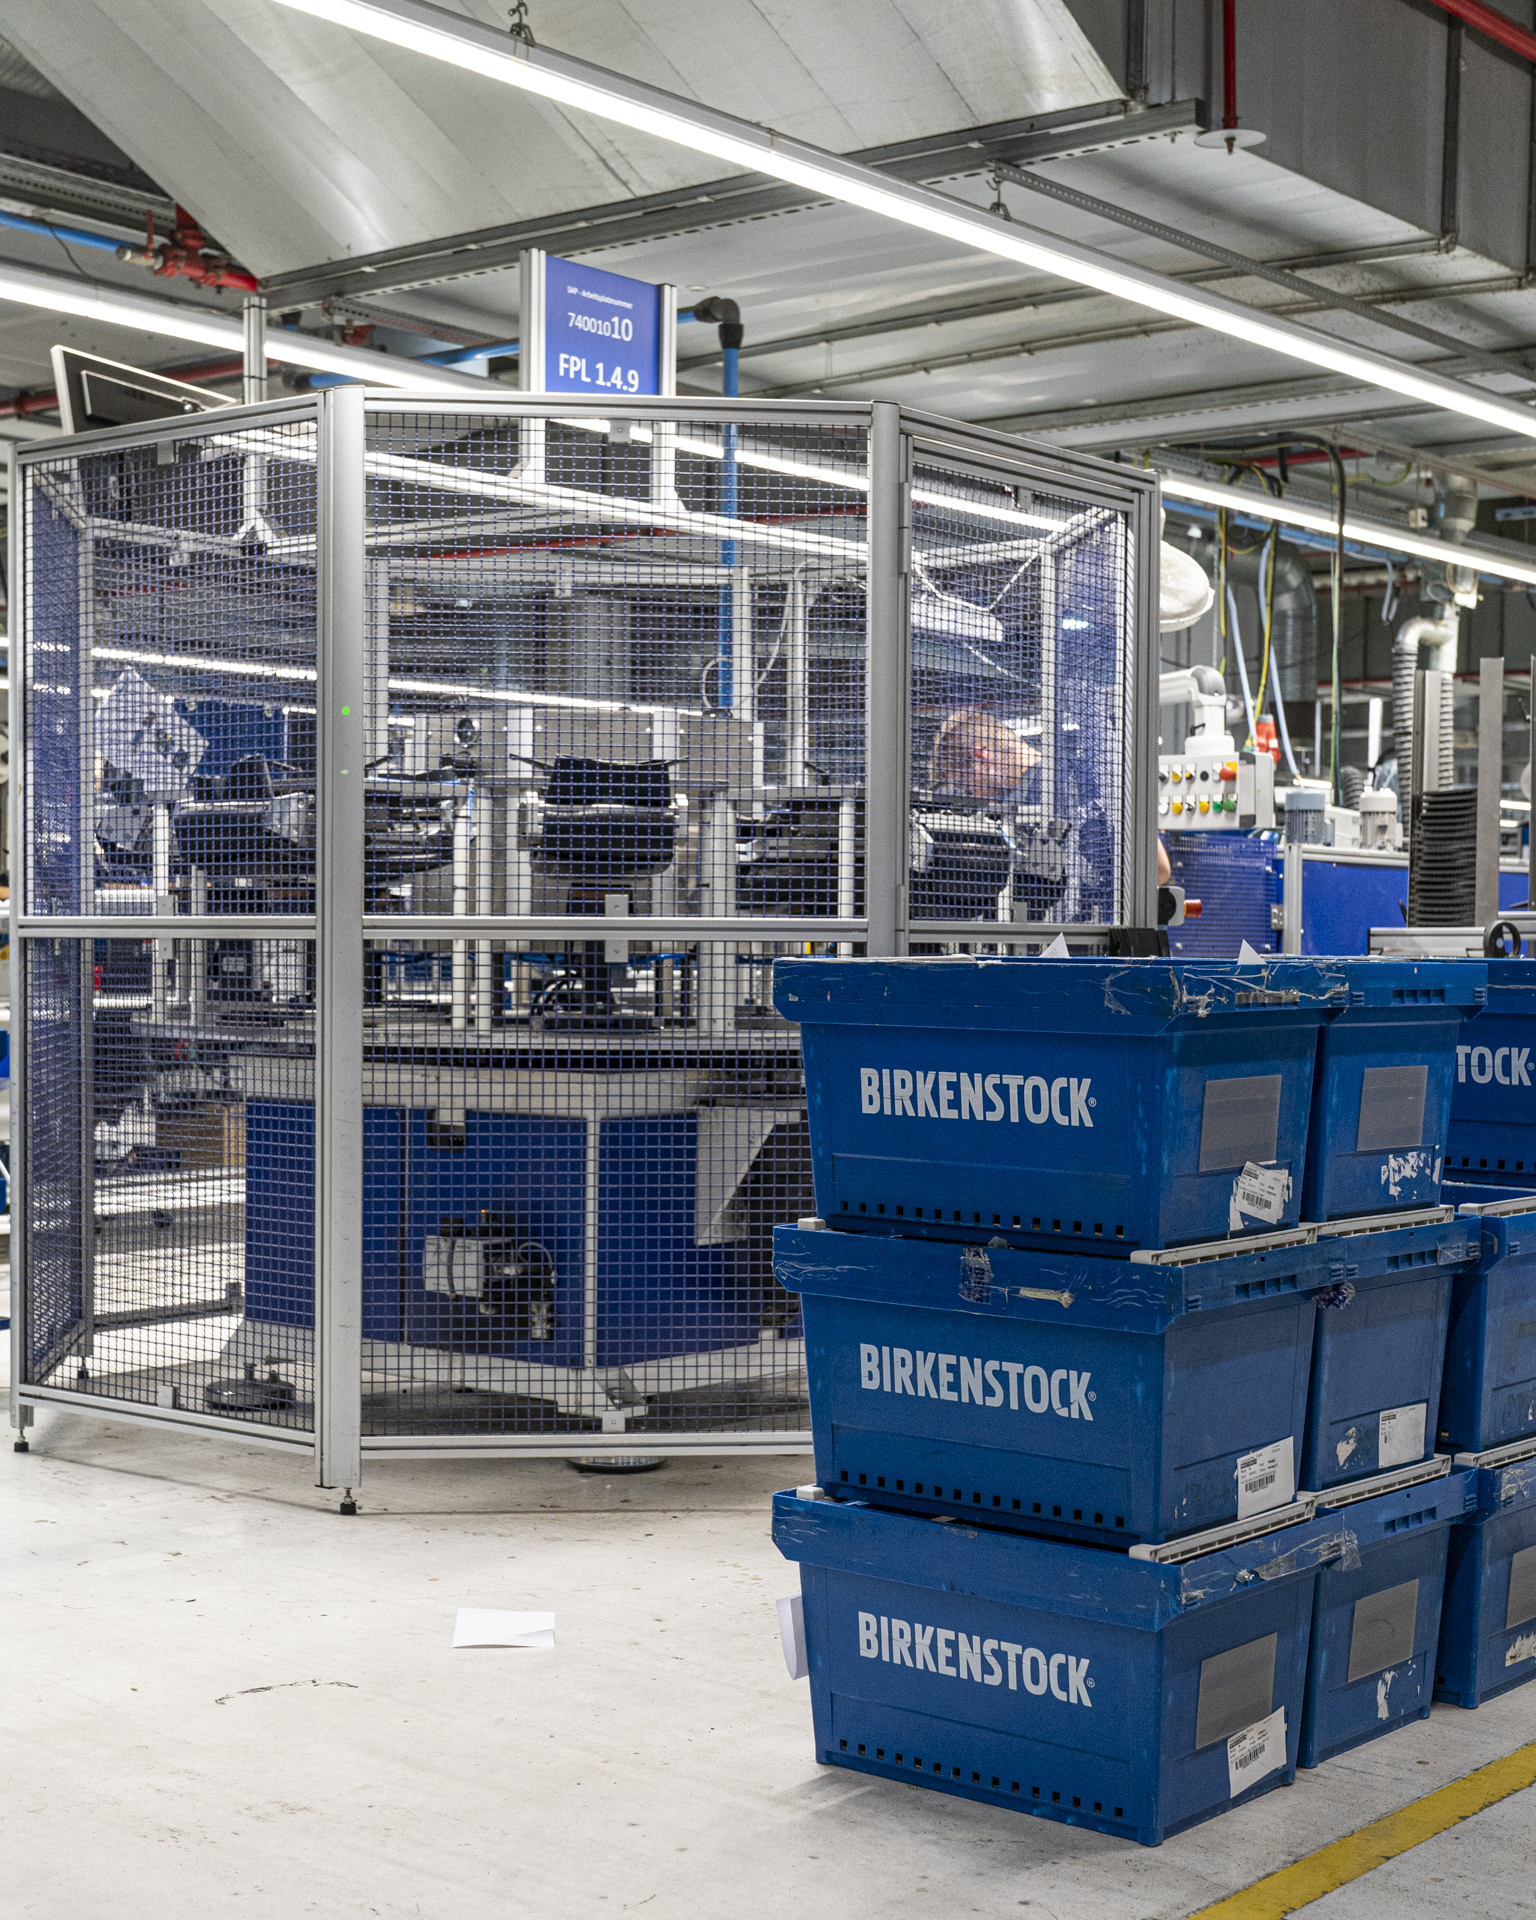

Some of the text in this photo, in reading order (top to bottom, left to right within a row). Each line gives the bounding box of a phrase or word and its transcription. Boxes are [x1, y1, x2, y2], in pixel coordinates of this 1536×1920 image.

[567, 312, 633, 342] 74001010
[559, 353, 639, 393] FPL 1.4.9
